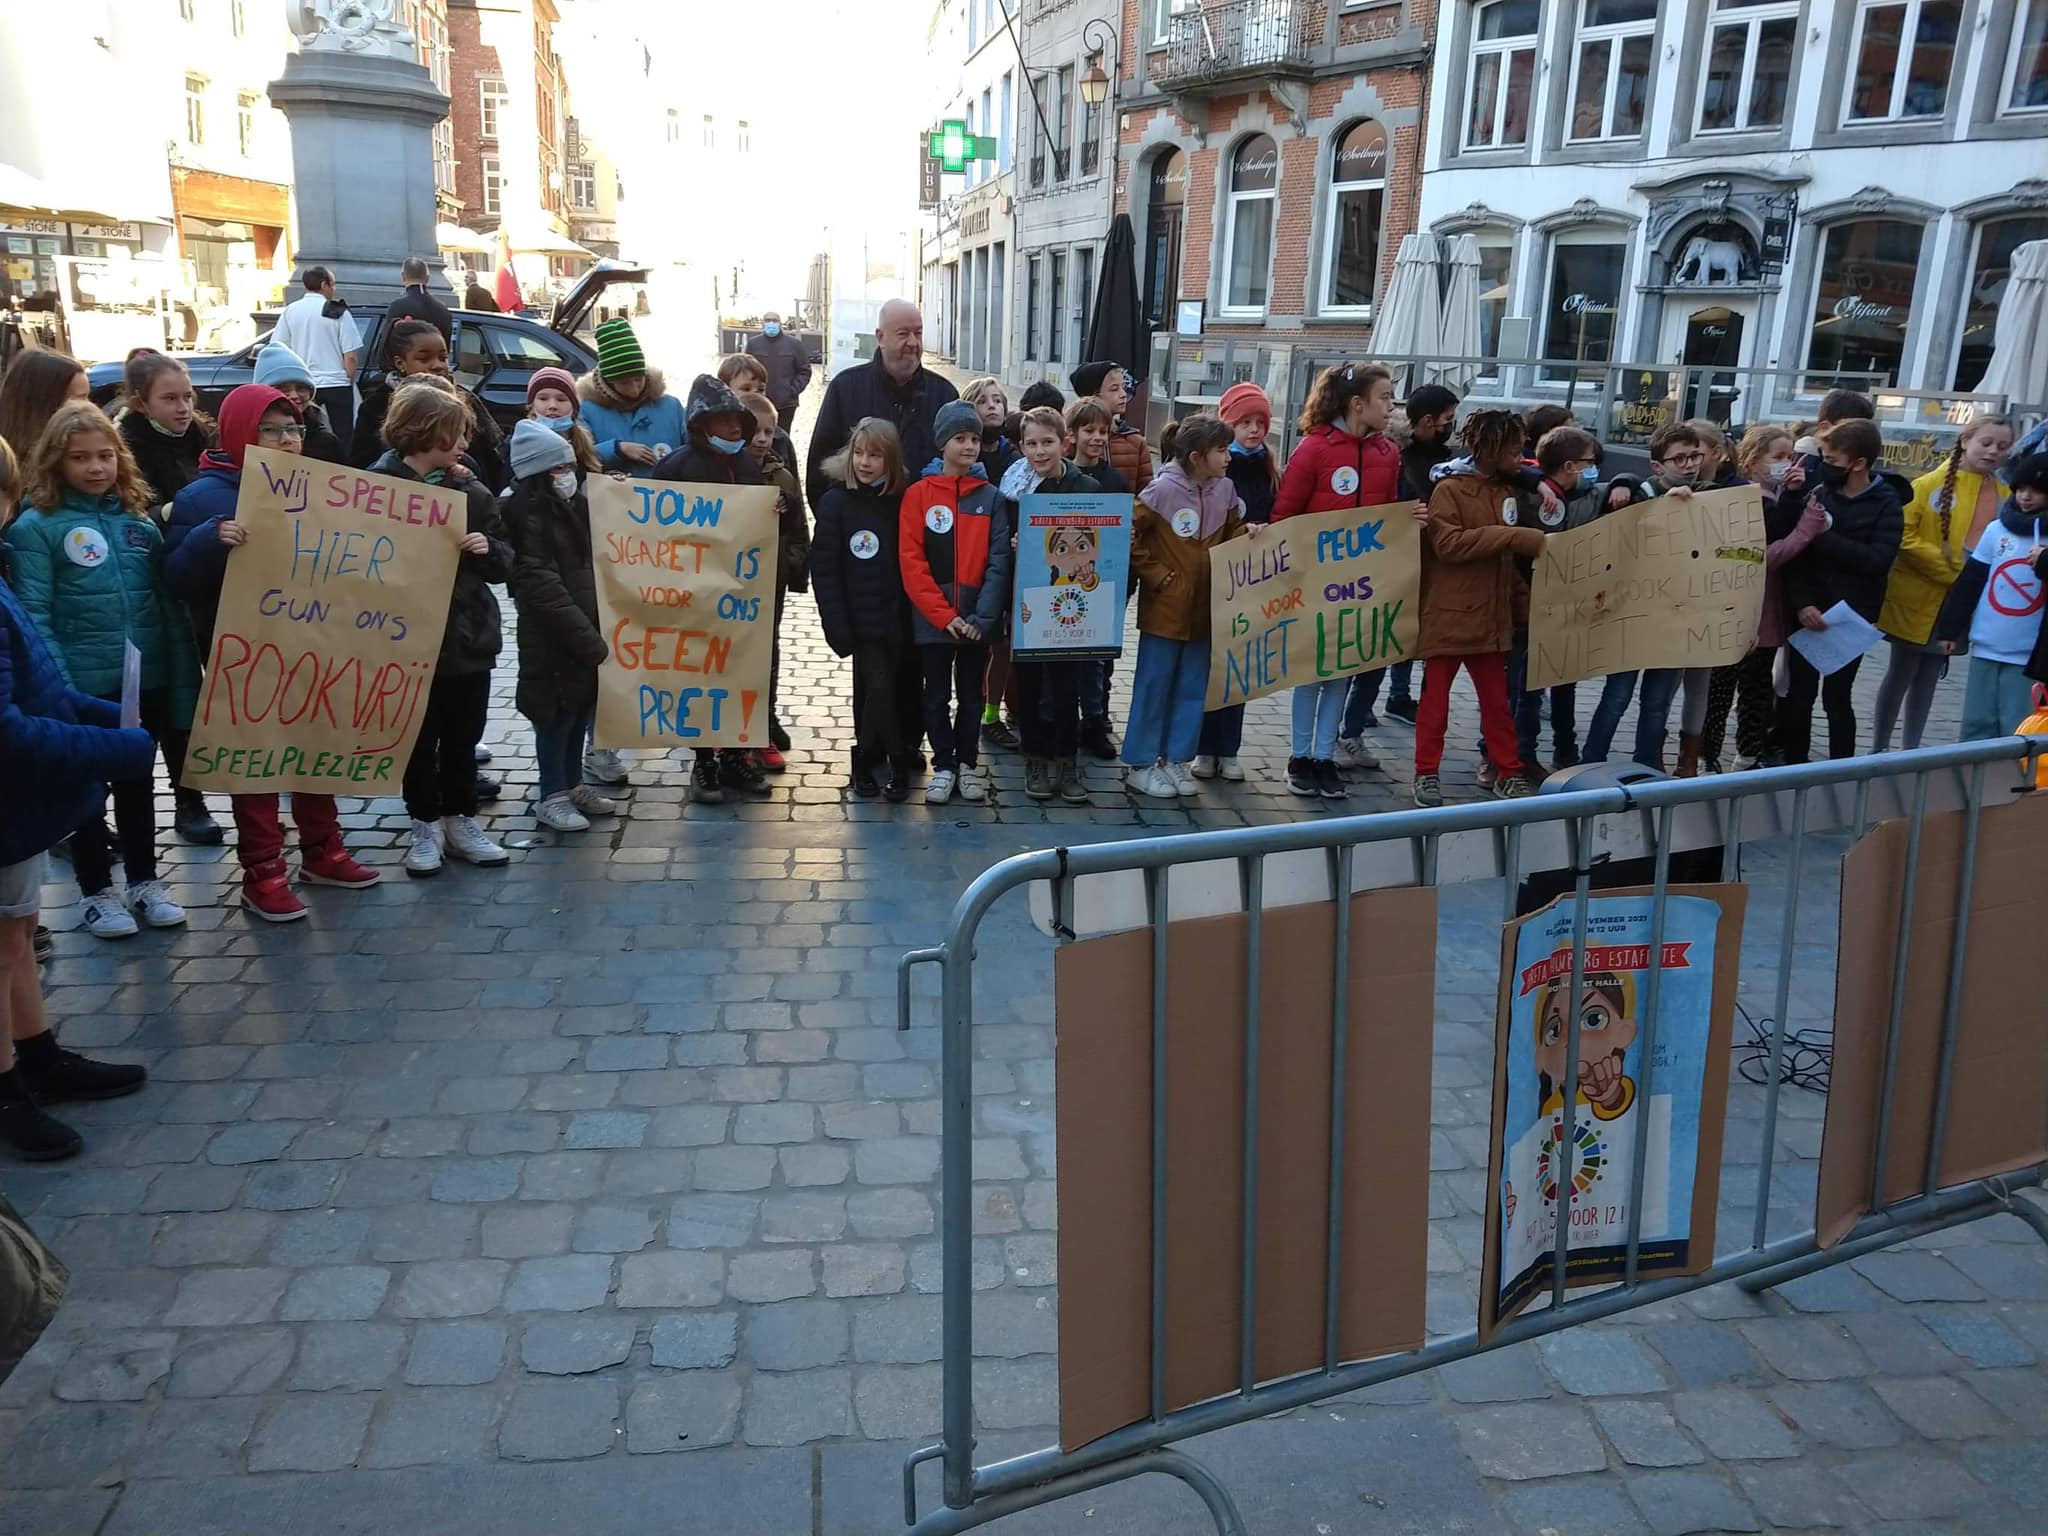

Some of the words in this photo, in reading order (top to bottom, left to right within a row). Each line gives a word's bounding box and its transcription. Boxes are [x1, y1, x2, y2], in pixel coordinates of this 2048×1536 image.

[25, 223, 57, 233] STONE
[101, 228, 132, 238] STONE
[326, 474, 453, 528] SPELEN
[627, 486, 724, 528] JOUW
[606, 532, 711, 575] SIGARET
[735, 547, 761, 580] IS
[1226, 540, 1291, 602] JULLIE
[1317, 519, 1386, 564] PEUK
[639, 586, 693, 609] VOOR
[716, 593, 761, 622] ONS
[1232, 612, 1249, 638] IS
[1260, 587, 1305, 620] VOOR
[1323, 576, 1374, 602] ONS
[1688, 565, 1759, 599] LIEVER
[258, 589, 331, 623] GUN
[355, 609, 407, 641] ONS
[612, 617, 732, 675] GEEN
[1224, 618, 1298, 704] NIET
[1316, 600, 1404, 677] LEUK
[1535, 613, 1649, 688] NIET
[191, 745, 398, 783] SPEELPLEZIER
